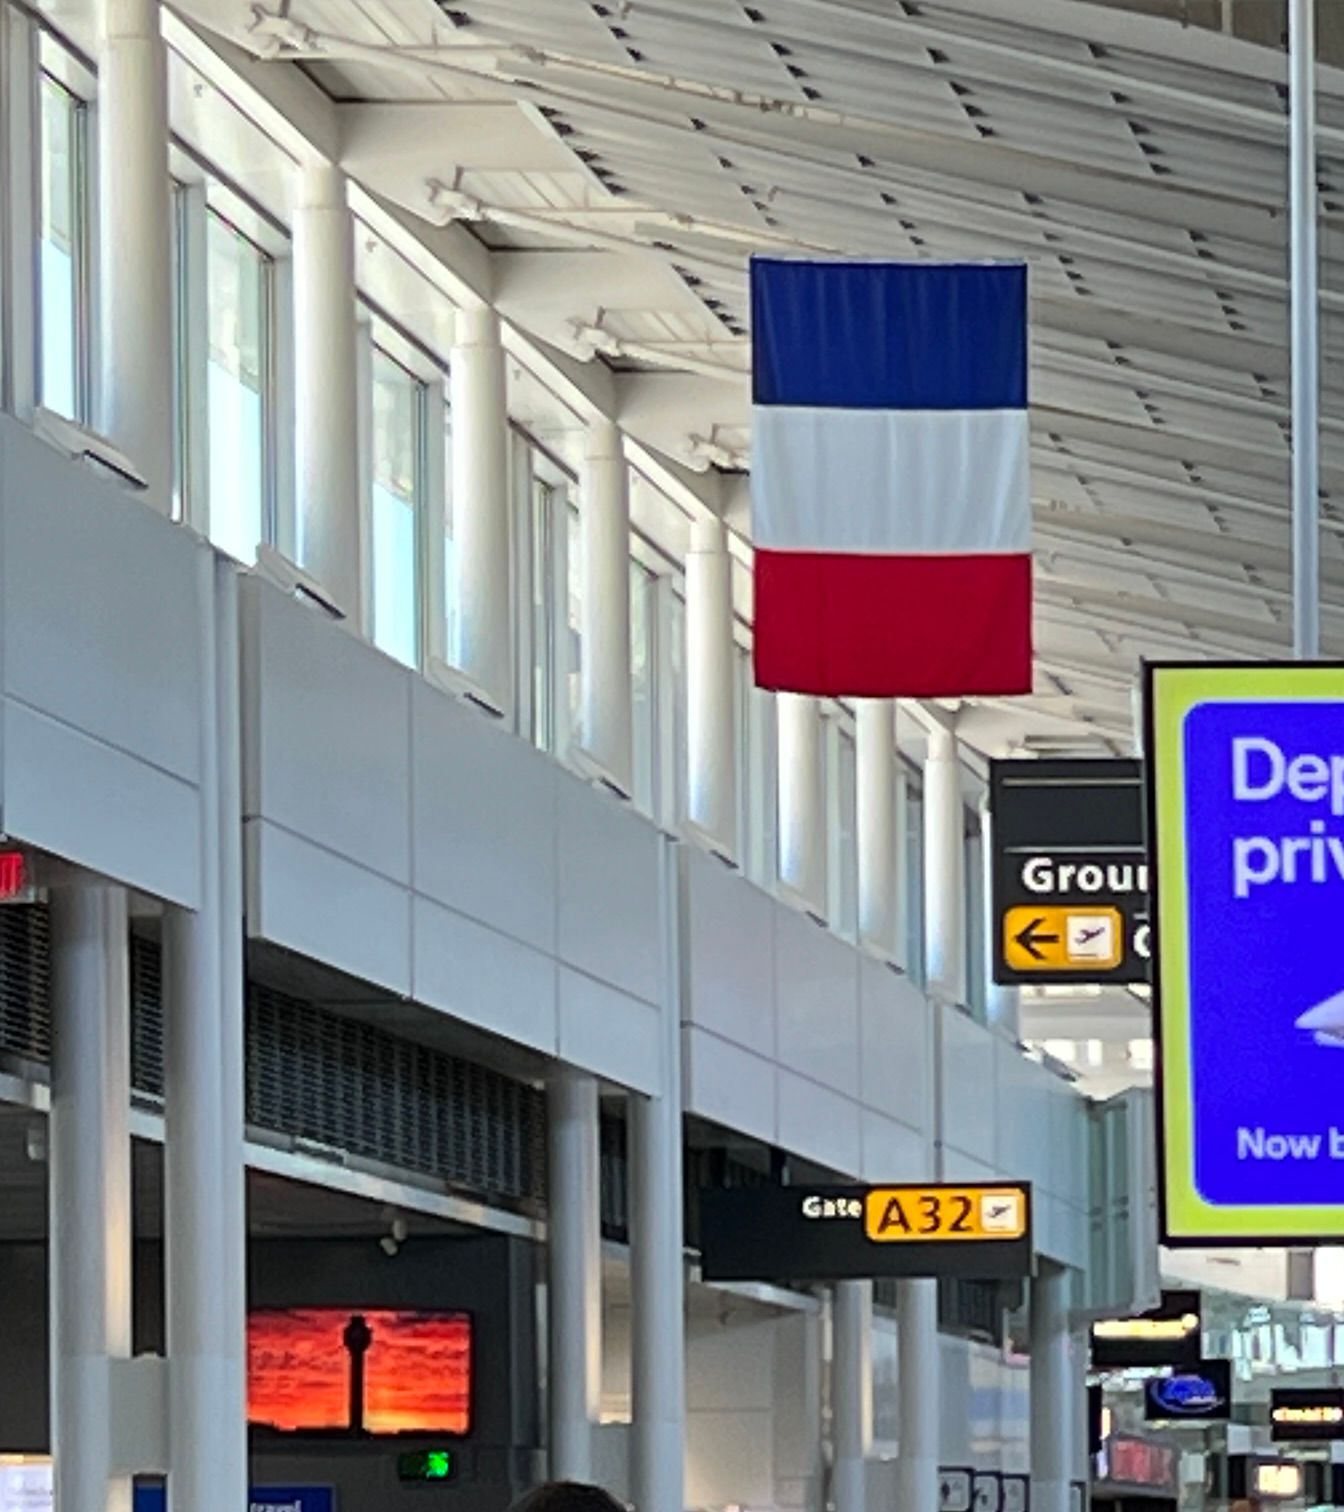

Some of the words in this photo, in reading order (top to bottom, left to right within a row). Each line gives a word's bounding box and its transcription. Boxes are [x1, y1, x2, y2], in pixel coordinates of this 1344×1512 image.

[1236, 1127, 1321, 1160] Now
[802, 1195, 863, 1219] Gate
[876, 1195, 974, 1235] A32
